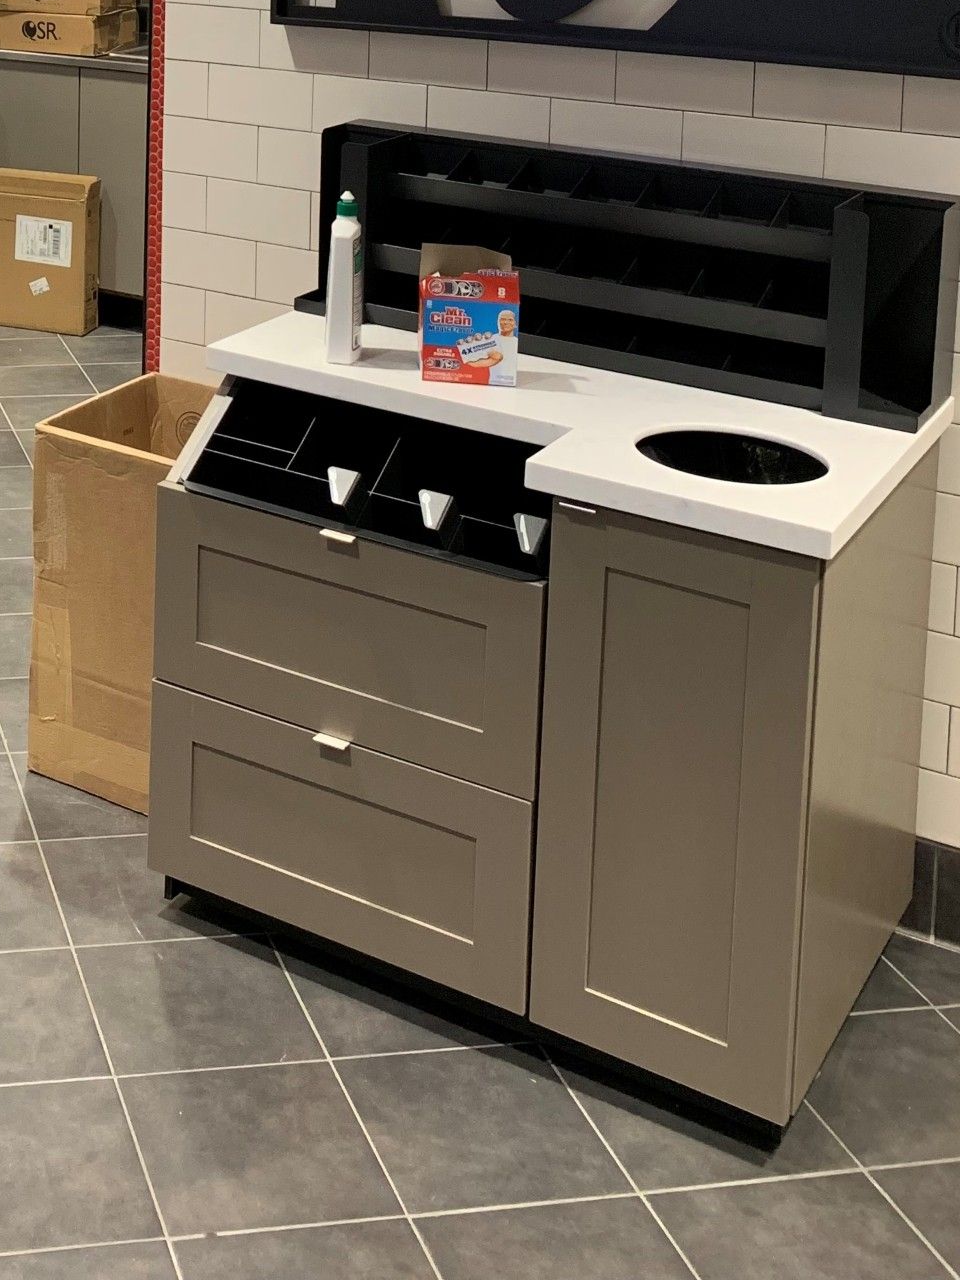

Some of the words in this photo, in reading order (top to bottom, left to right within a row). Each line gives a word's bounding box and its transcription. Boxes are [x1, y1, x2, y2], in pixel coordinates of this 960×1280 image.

[22, 20, 58, 41] QSR
[497, 287, 506, 296] 8
[445, 307, 466, 317] Mr.
[431, 312, 472, 326] Clean
